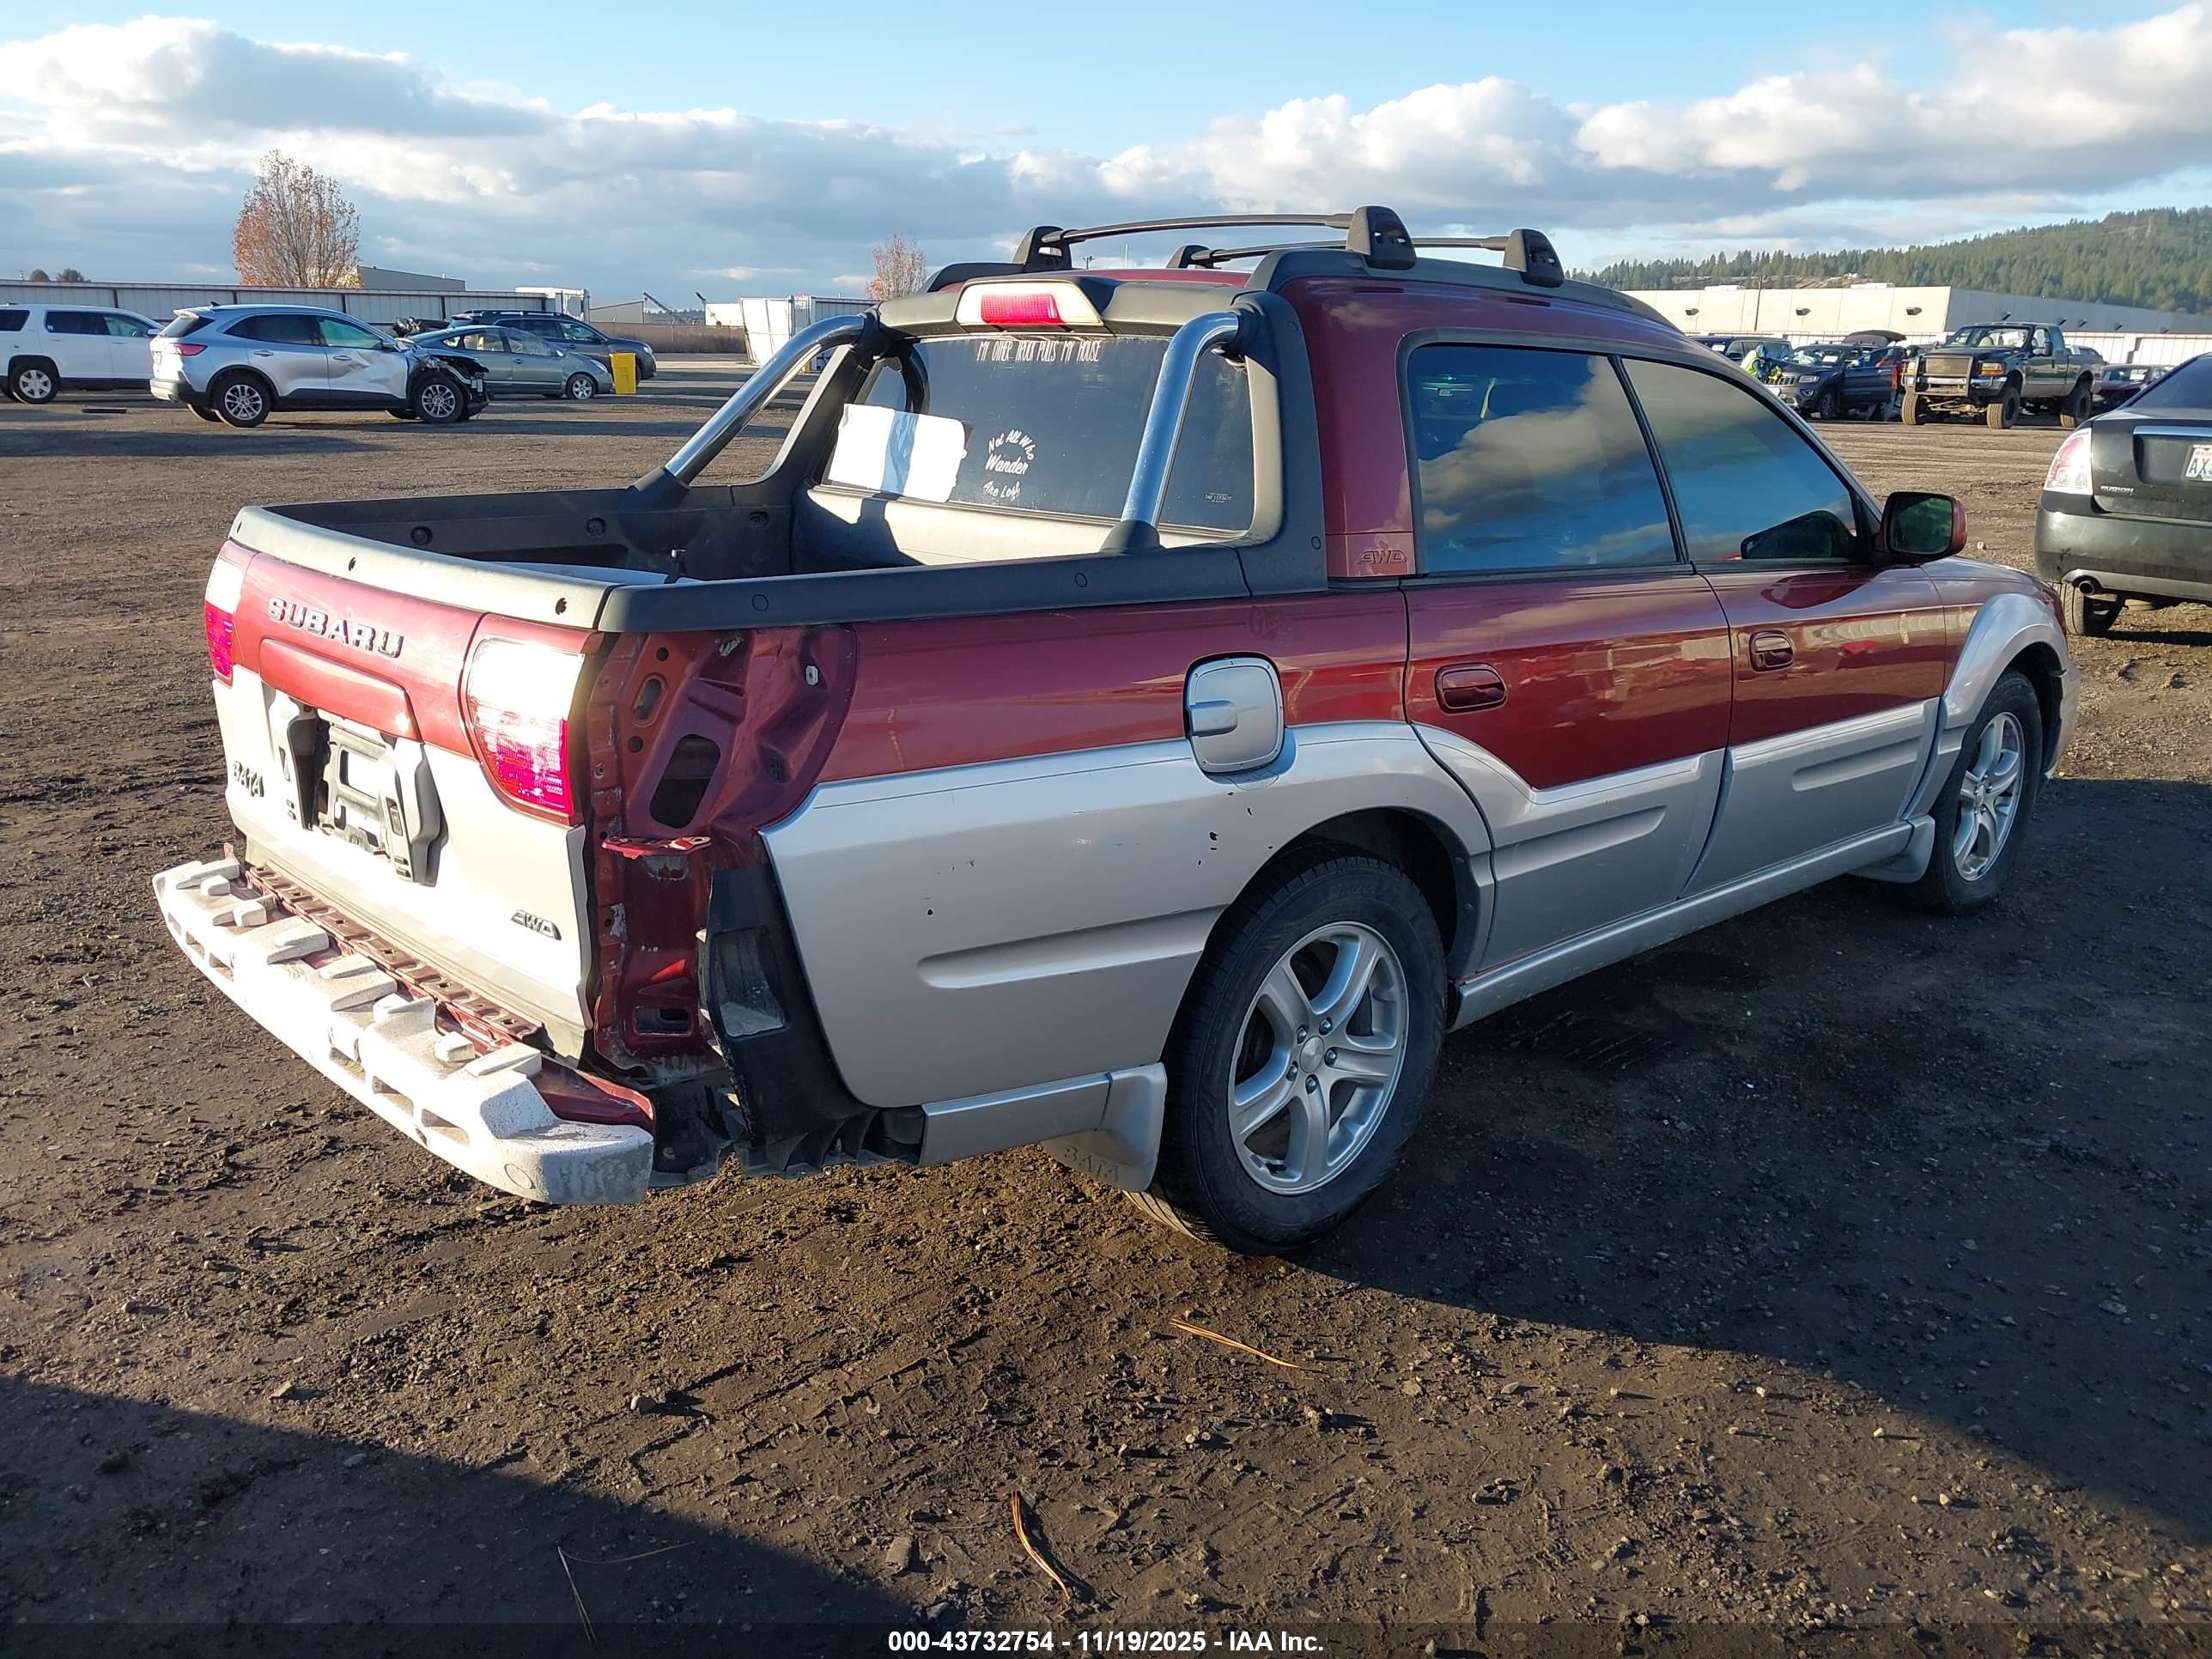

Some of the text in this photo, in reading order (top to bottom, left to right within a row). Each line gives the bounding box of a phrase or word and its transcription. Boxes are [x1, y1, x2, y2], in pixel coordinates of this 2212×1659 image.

[976, 340, 1102, 362] MY OTHER TRUCK PULLS MY HOUSE
[988, 428, 1036, 460] Not All Who
[985, 453, 1029, 475] Wander
[2189, 458, 2212, 475] AX
[983, 480, 1020, 501] Are Lost
[267, 597, 404, 659] SUBARU
